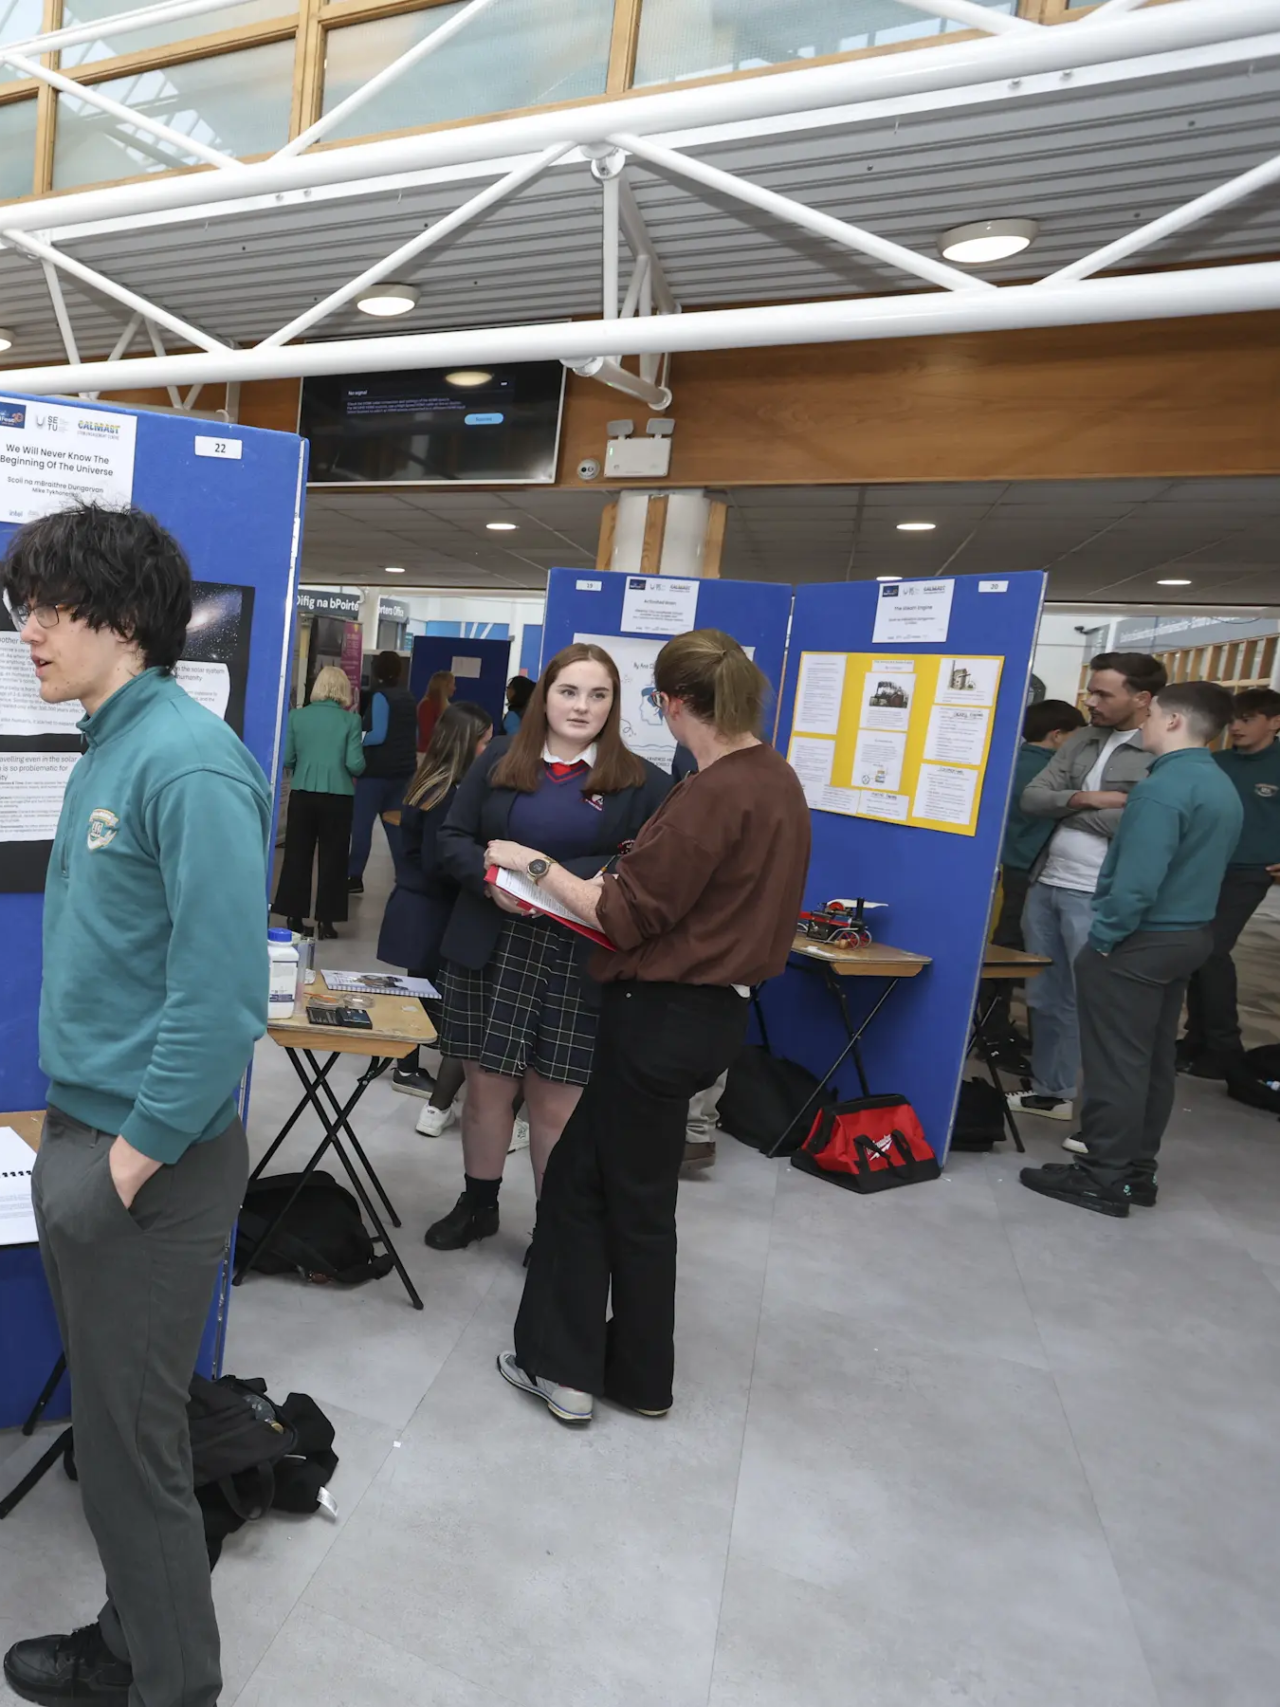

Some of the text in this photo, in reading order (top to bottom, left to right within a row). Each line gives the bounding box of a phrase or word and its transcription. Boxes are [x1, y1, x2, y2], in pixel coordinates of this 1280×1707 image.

[78, 420, 120, 434] CALMAST
[6, 444, 109, 465] We Will Never Know The
[215, 443, 226, 453] 22
[0, 455, 113, 476] Beginning Of The Universe
[34, 480, 67, 490] mBraithre
[68, 483, 104, 494] Dungarvan
[316, 599, 328, 608] na
[19, 765, 57, 773] problematic
